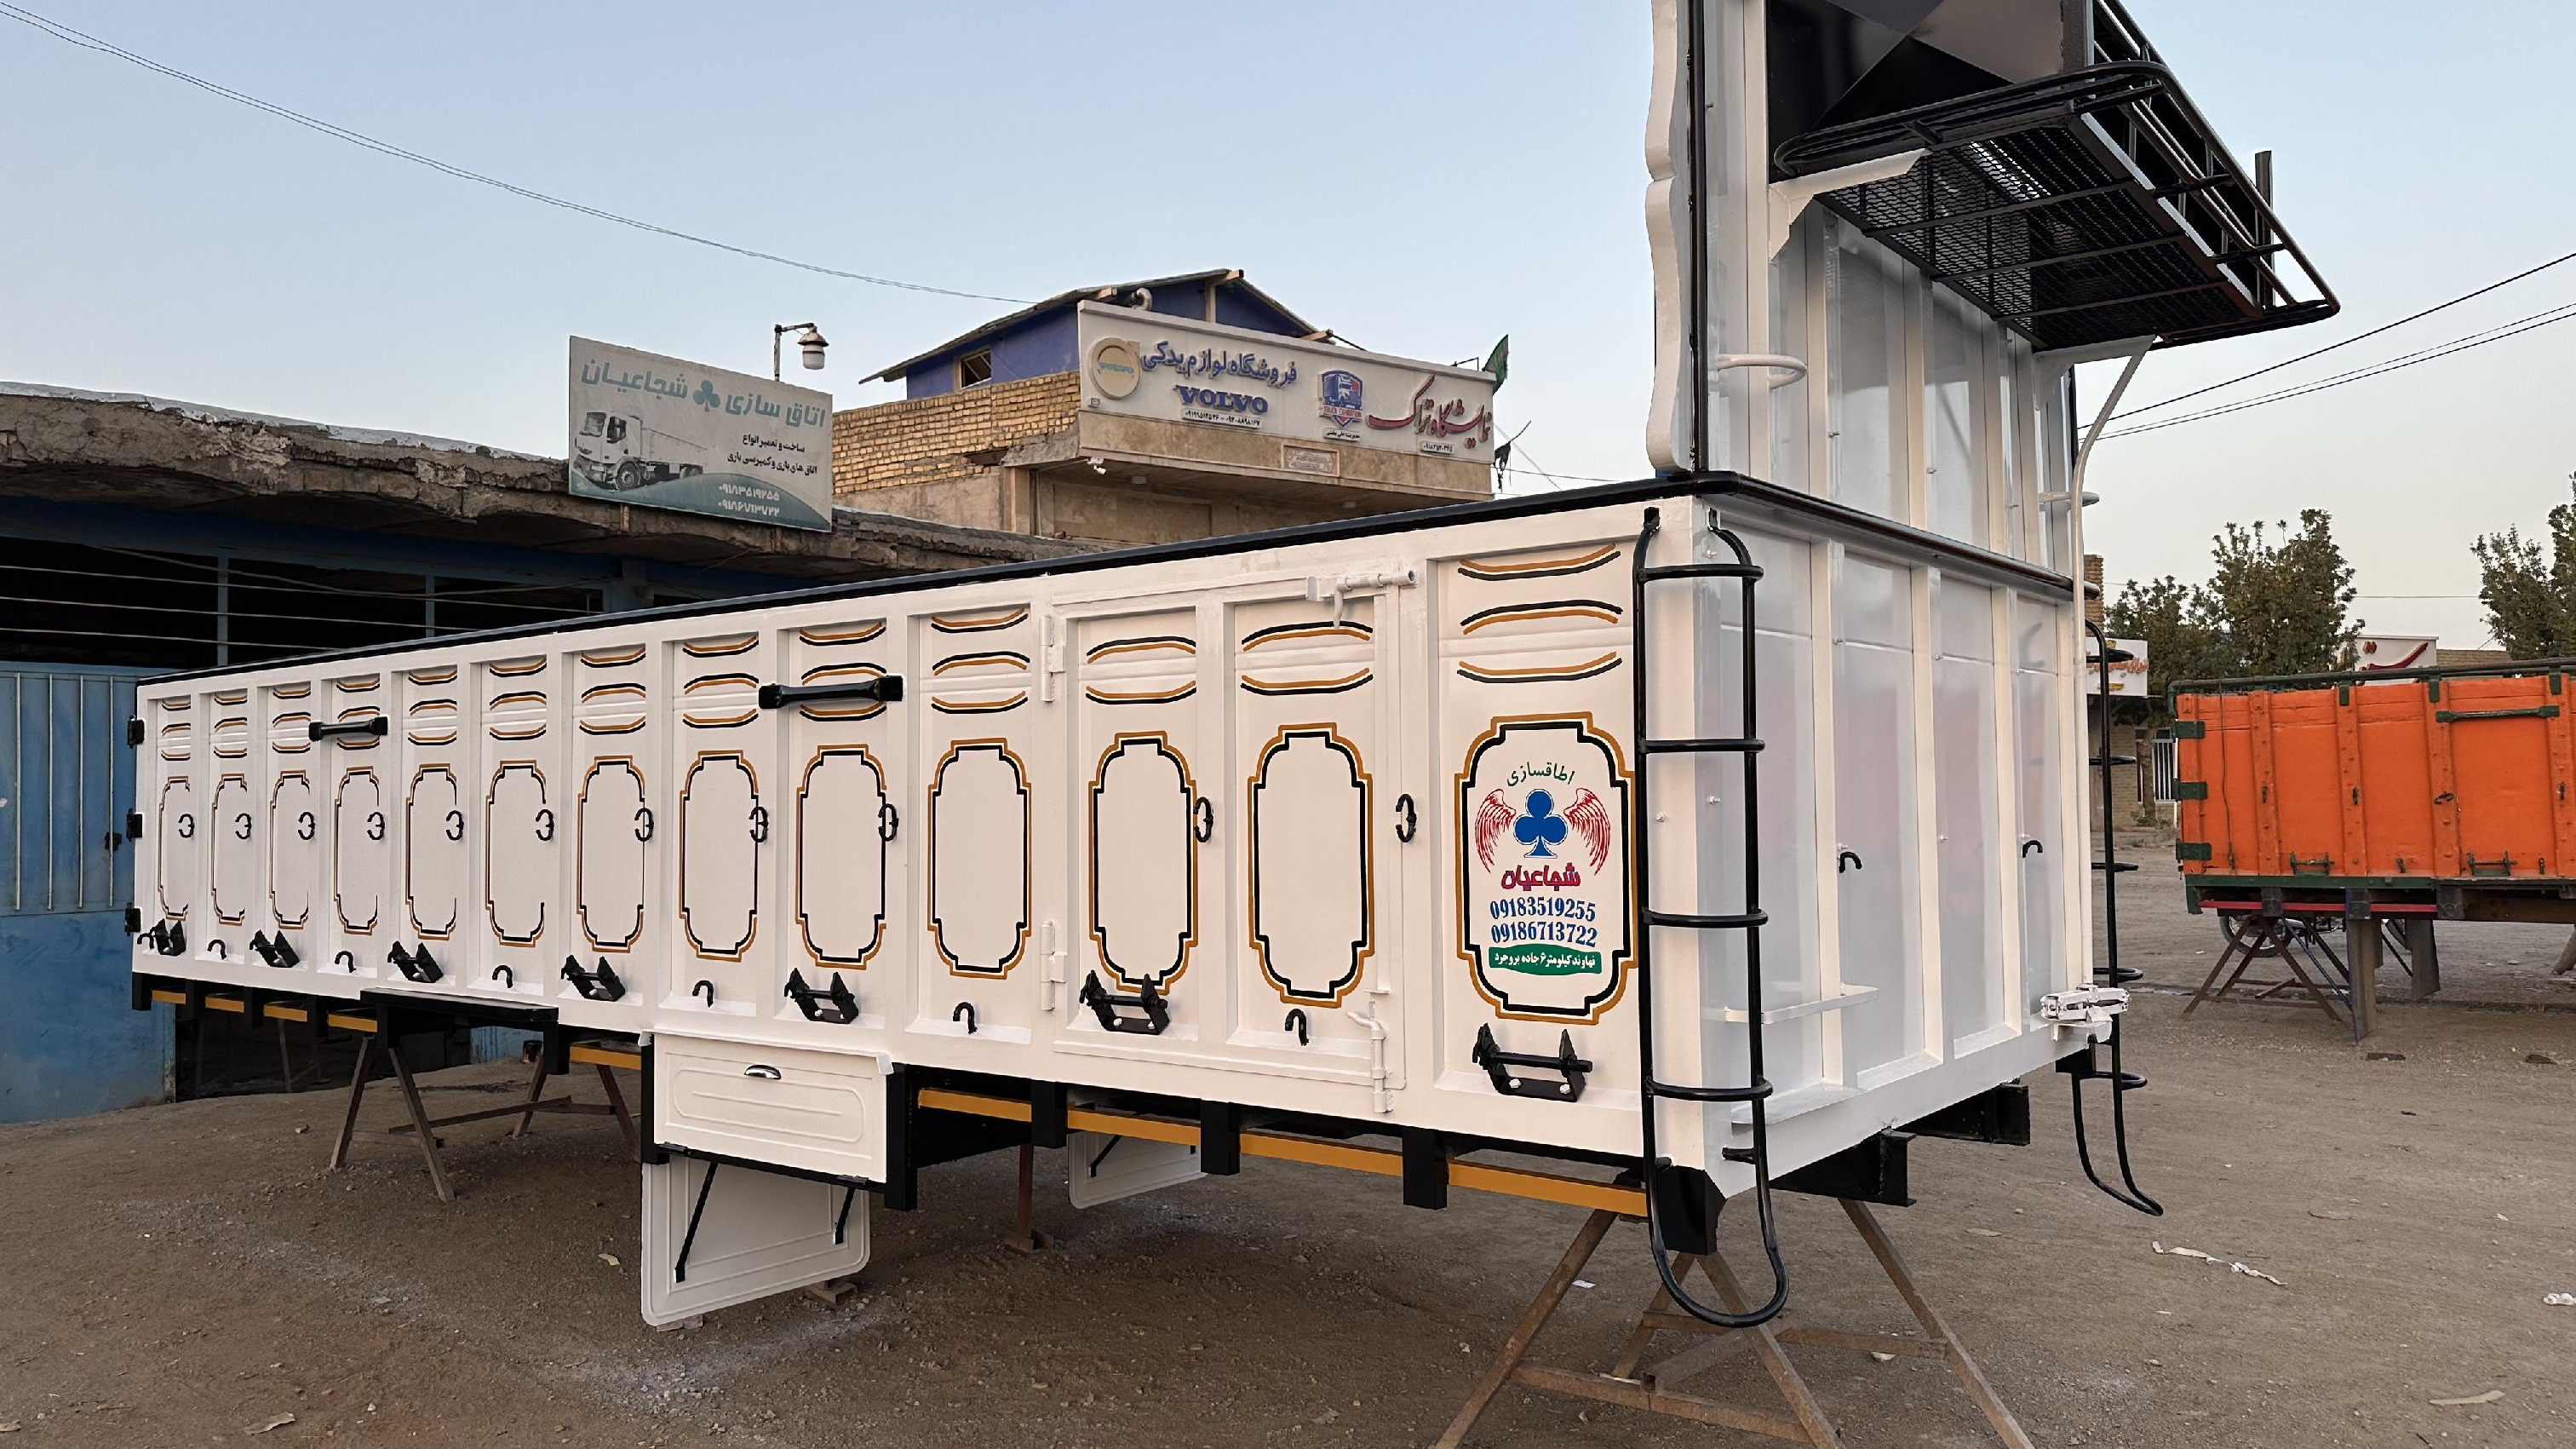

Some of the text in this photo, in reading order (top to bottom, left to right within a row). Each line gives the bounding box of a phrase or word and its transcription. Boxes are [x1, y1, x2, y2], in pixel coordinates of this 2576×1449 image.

[1098, 361, 1135, 374] VOLVO
[1141, 341, 1298, 388] فروشگاه لوازم یدکی
[581, 359, 826, 428] اتاق سازی شجاعیان
[1173, 384, 1268, 415] VOLVO
[743, 434, 805, 452] ساخت و تعمیر انواع
[727, 451, 742, 463] باری
[743, 456, 772, 467] کمپرسی
[771, 461, 776, 469] و
[789, 463, 804, 474] های
[804, 465, 818, 475] اتاق
[718, 483, 780, 502] ۰۹۱۸۳۵۱۹۲۵۵
[718, 499, 780, 517] ۰۹۱۸۶۷۱۳۷۲۲
[1500, 862, 1581, 892] شجاعیان
[1489, 896, 1597, 923] 09183519255
[1490, 921, 1598, 948] 09186713722
[1495, 952, 1520, 966] بروجرد
[1521, 952, 1539, 965] جاده
[1571, 955, 1596, 969] نهاوند
